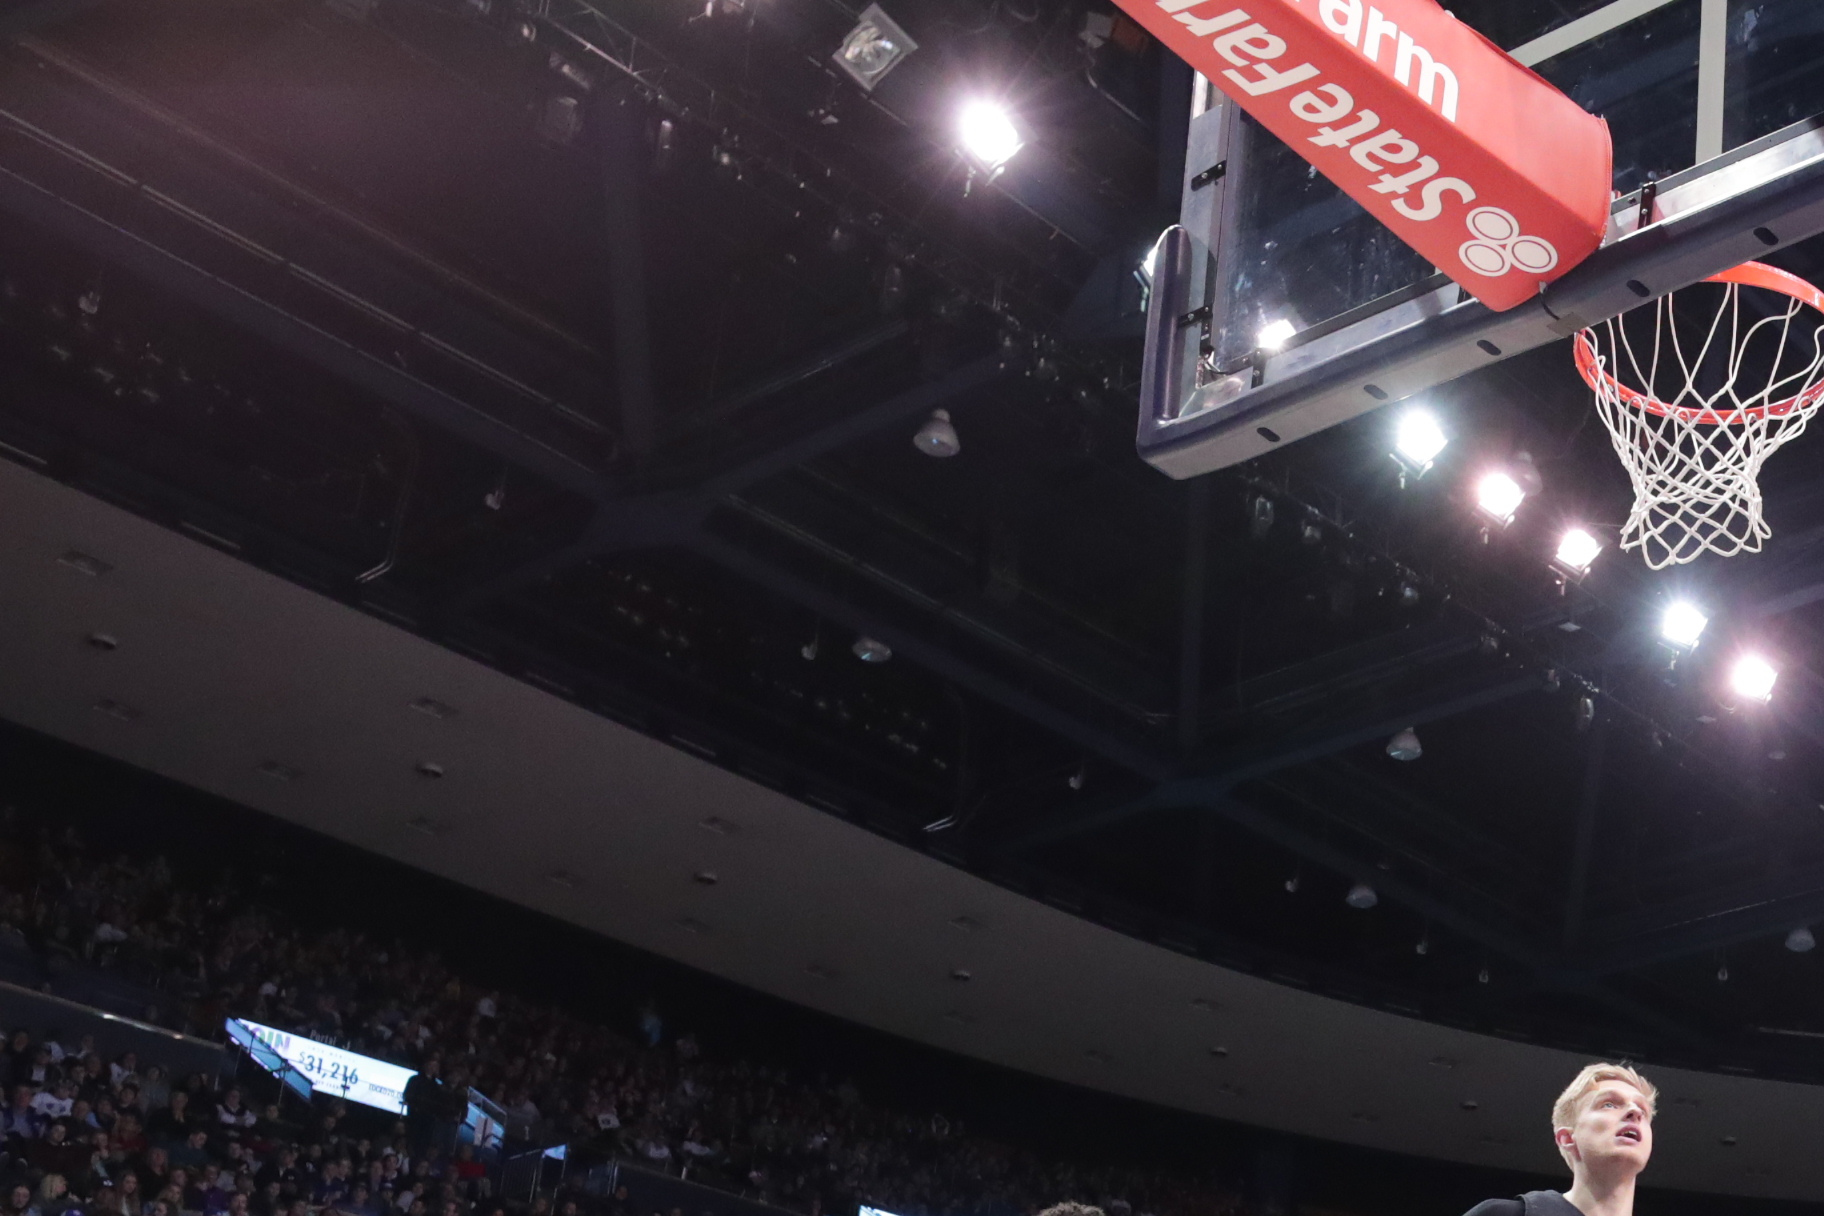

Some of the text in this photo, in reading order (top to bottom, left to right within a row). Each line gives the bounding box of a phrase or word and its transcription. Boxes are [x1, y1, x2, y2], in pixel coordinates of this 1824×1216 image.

[1292, 0, 1459, 122] arm
[1289, 82, 1476, 222] State
[249, 1026, 291, 1053] OIN
